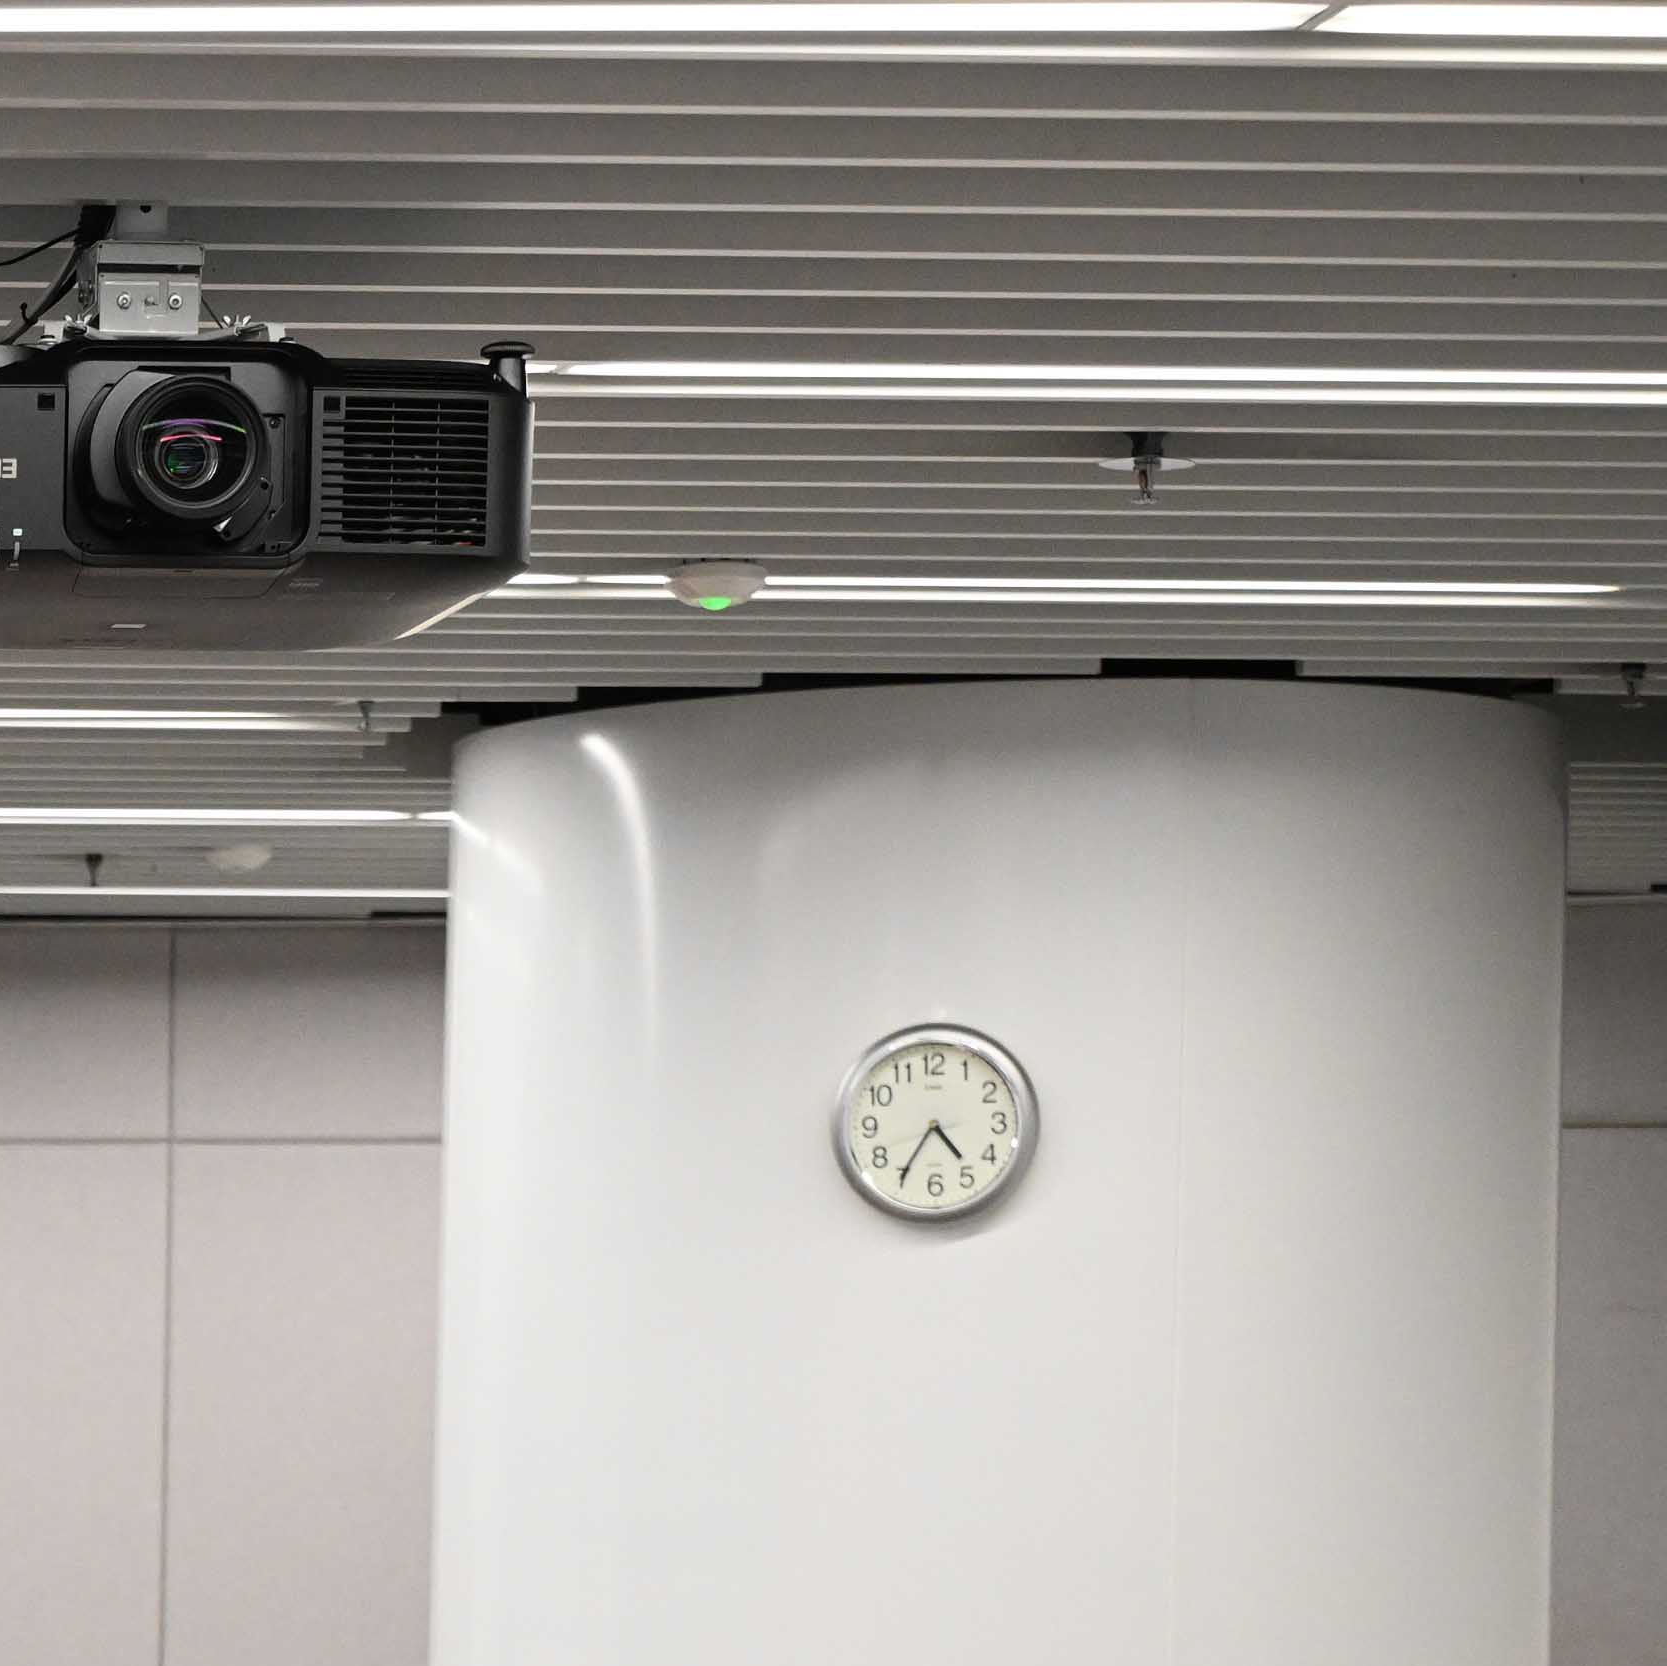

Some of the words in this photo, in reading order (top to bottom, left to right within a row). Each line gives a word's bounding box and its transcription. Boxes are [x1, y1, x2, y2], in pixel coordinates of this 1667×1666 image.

[894, 1063, 912, 1084] 11
[923, 1053, 946, 1076] 12
[962, 1060, 969, 1081] 1
[869, 1084, 893, 1107] 10
[982, 1082, 998, 1104] 2
[862, 1116, 879, 1139] 9
[991, 1112, 1008, 1135] 3
[872, 1146, 889, 1169] 8
[981, 1143, 997, 1165] 4
[927, 1174, 944, 1197] 6
[959, 1166, 975, 1189] 5
